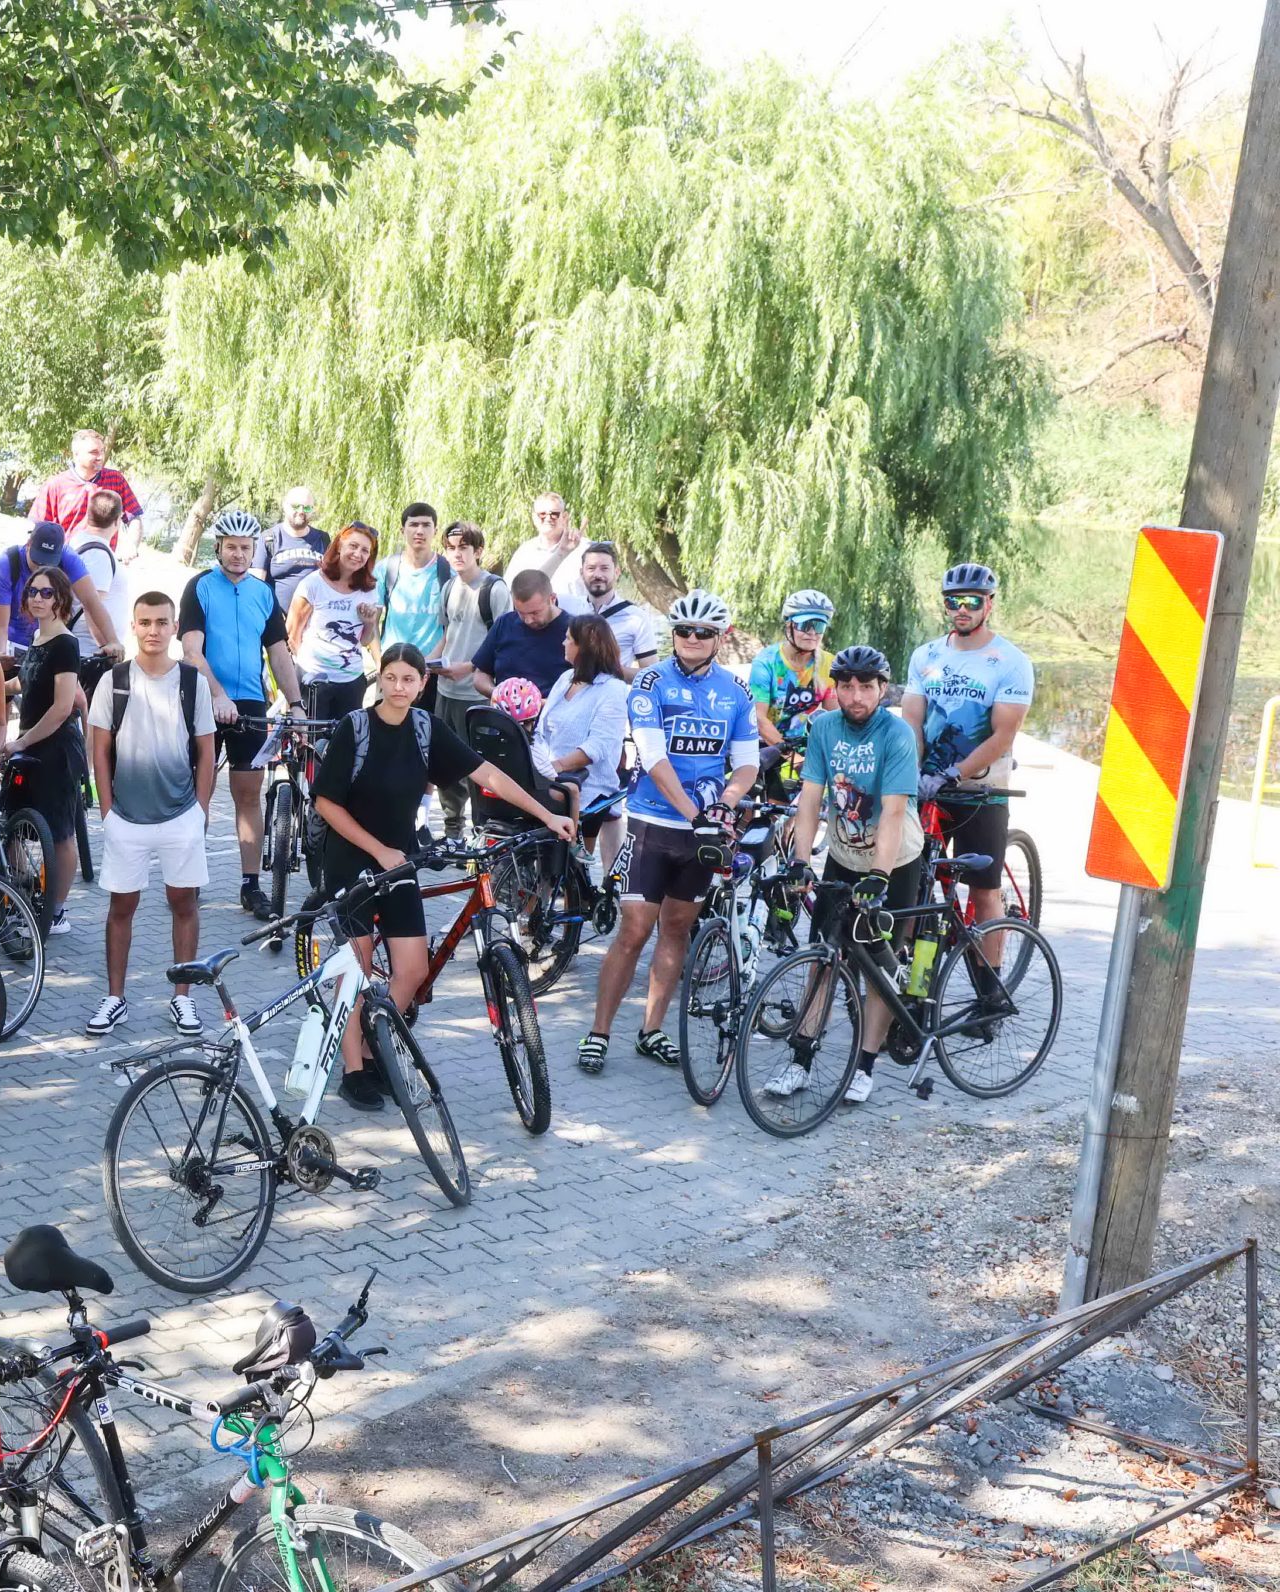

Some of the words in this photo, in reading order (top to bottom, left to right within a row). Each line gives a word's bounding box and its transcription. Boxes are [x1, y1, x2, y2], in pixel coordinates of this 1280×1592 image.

[679, 721, 720, 736] SAXO
[676, 739, 717, 752] BANK
[848, 762, 875, 774] MAN
[117, 1377, 184, 1412] SCOTT
